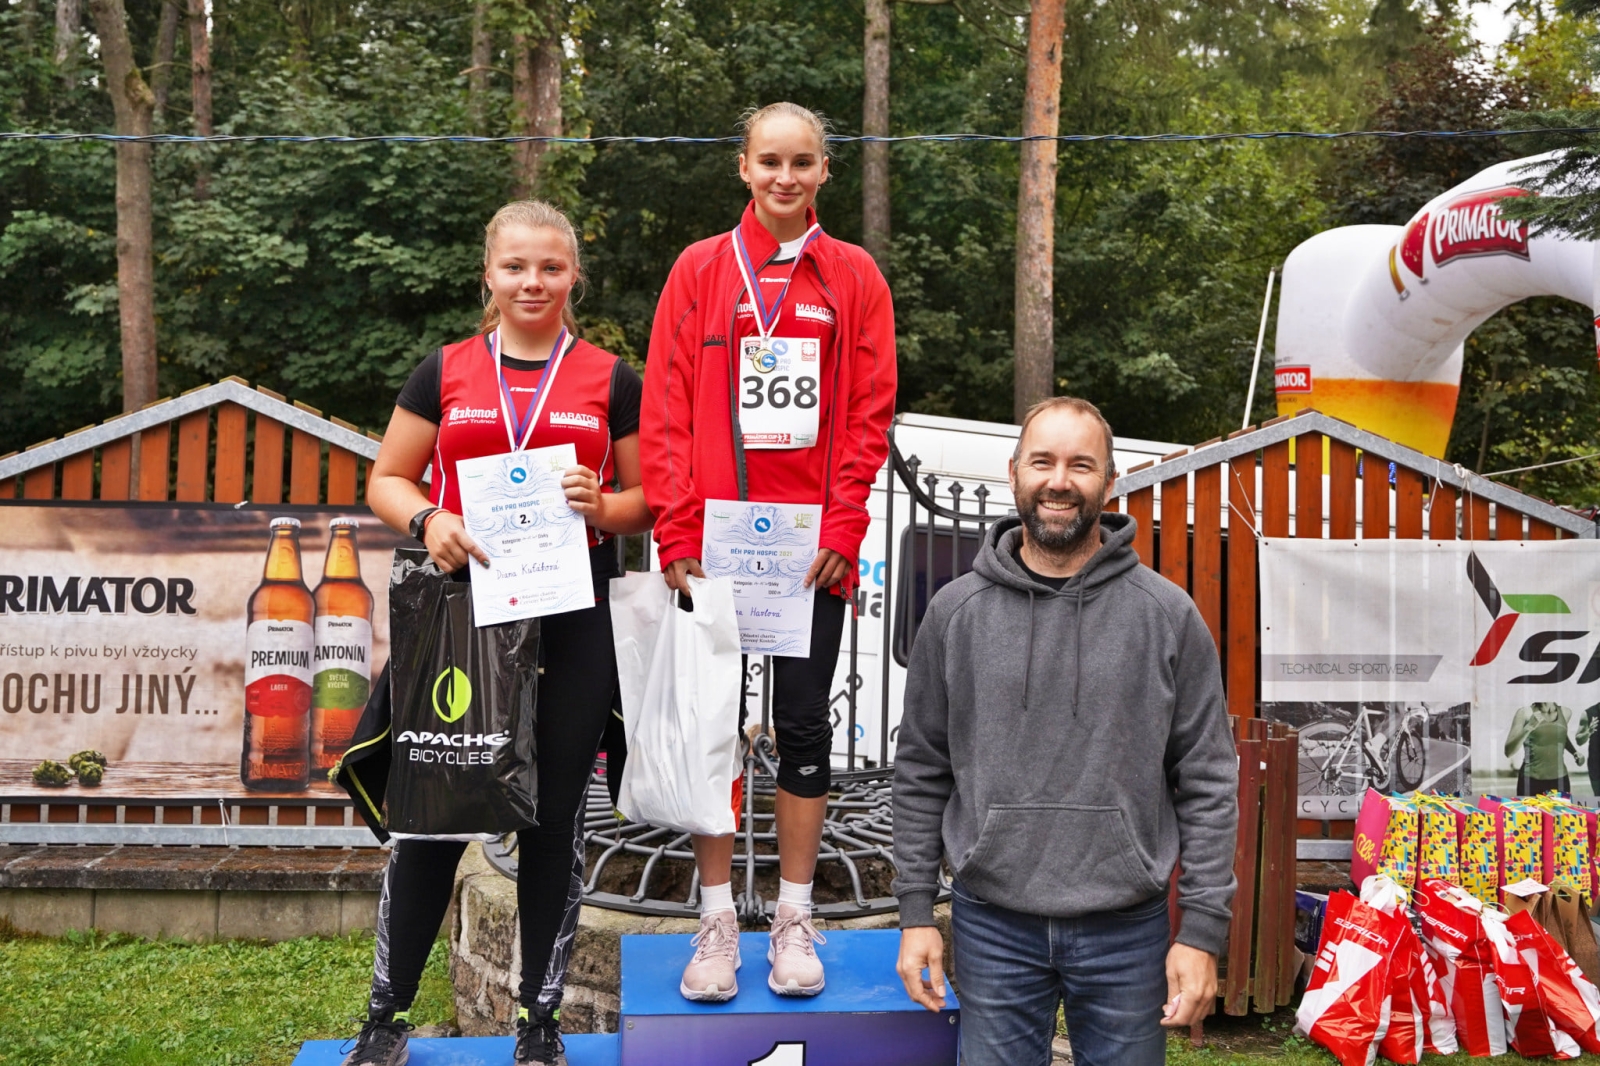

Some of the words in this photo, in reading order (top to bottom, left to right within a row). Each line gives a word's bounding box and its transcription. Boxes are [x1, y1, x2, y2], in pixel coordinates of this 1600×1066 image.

[742, 376, 818, 409] 368
[550, 411, 599, 425] MARATON
[518, 500, 540, 508] HOSPIC
[520, 514, 531, 524] 2.
[756, 561, 764, 570] 1.
[496, 569, 517, 580] Diana
[50, 644, 59, 657] k
[64, 644, 98, 660] pivu
[103, 645, 127, 660] byl
[132, 646, 198, 661] vždycky
[314, 644, 365, 664] ANTONÍN
[252, 650, 310, 670] PREMIUM
[1280, 663, 1344, 675] TECHNICAL
[1348, 663, 1418, 675] SPORTWEAR
[2, 672, 102, 714] OCHU
[116, 666, 218, 715] JINÝ...
[270, 684, 288, 692] LAGER
[409, 748, 494, 765] BICYCLES
